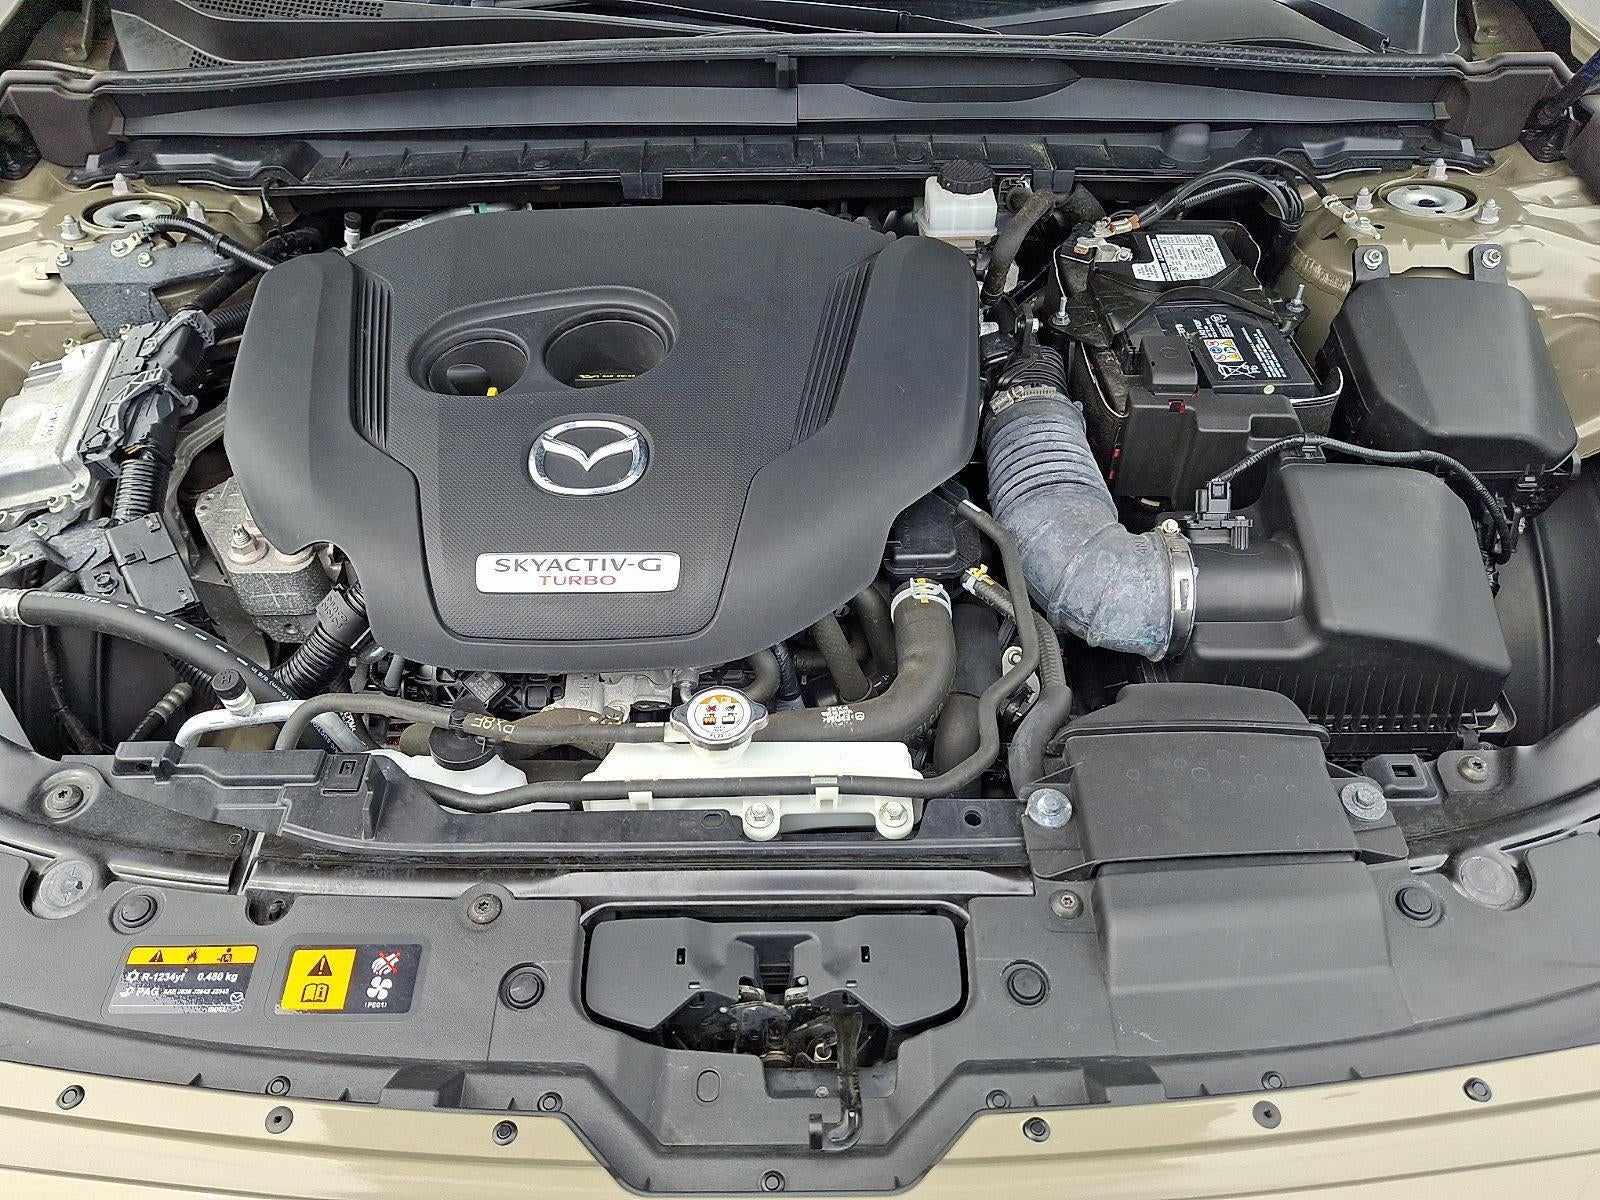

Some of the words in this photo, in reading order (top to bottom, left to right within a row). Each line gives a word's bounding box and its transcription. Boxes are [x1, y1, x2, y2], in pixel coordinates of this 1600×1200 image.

[494, 557, 662, 573] SKYACTIV-G
[539, 575, 617, 586] TURBO
[141, 971, 186, 984] R-1234yf
[197, 971, 224, 982] 0.480
[224, 971, 239, 983] kg
[136, 986, 160, 997] PAG
